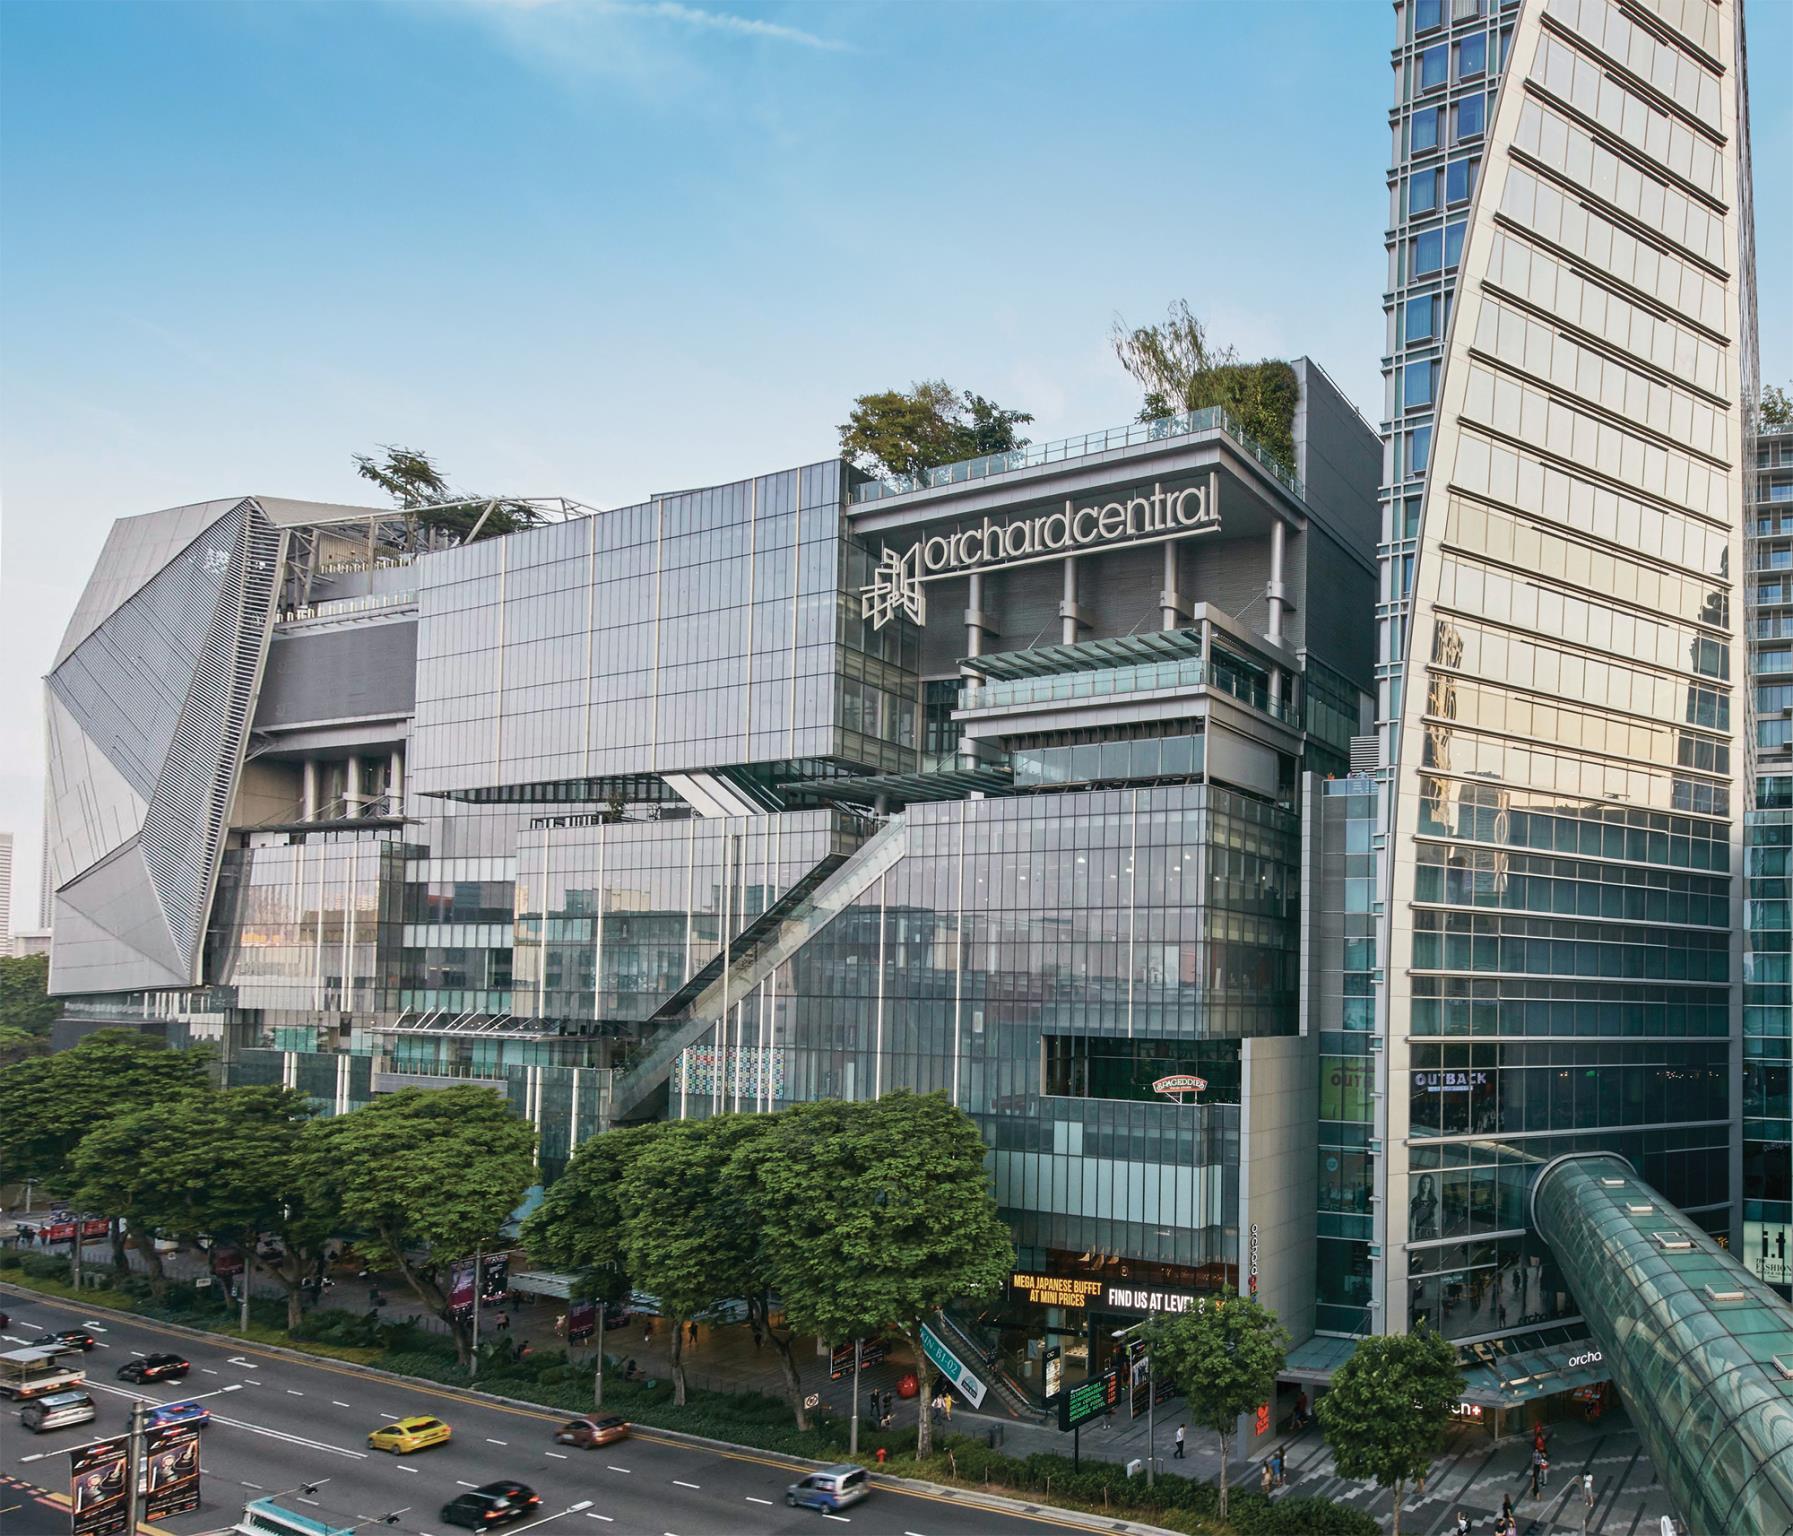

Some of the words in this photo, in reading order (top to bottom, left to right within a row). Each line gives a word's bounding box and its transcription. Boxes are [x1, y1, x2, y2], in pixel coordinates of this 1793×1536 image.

[924, 471, 1221, 571] orchardcentral
[1415, 1073, 1487, 1086] OUTBACK
[1013, 1274, 1035, 1289] MEGA
[1036, 1276, 1073, 1292] JAPANESE
[1073, 1280, 1103, 1296] BUFFET
[1029, 1289, 1040, 1302] AT
[1041, 1290, 1058, 1305] MINI
[1058, 1292, 1085, 1308] PRICES
[1108, 1288, 1133, 1308] FIND
[1134, 1290, 1148, 1309] US
[1149, 1292, 1163, 1311] AT
